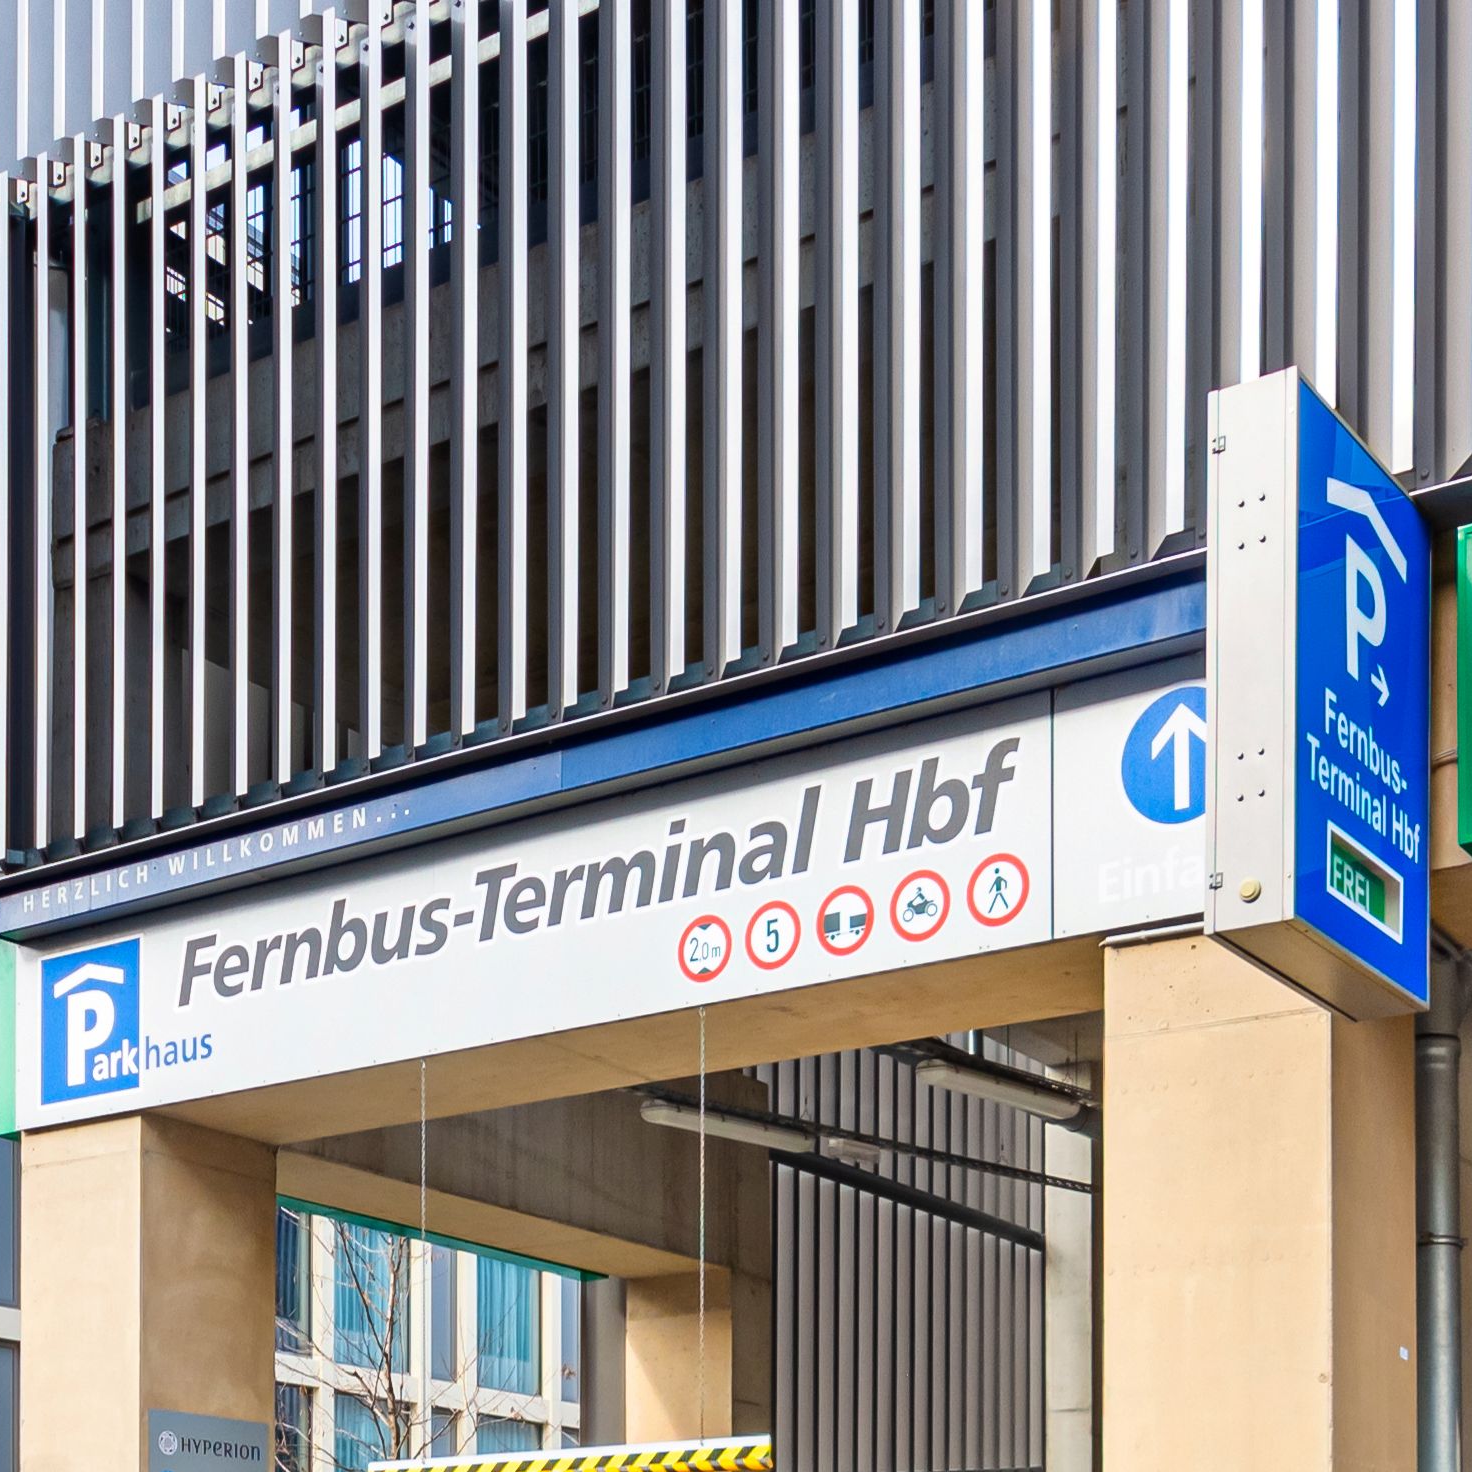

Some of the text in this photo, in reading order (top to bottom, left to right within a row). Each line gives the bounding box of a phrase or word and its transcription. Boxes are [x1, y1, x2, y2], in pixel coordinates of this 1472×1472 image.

[1325, 687, 1408, 795] Fernbus-
[1307, 732, 1421, 864] Terminal Hbf
[23, 864, 149, 913] HERZLICH
[178, 737, 1020, 1007] Fernbus-Terminal Hbf
[1333, 854, 1370, 913] FREI
[766, 918, 780, 953] 5
